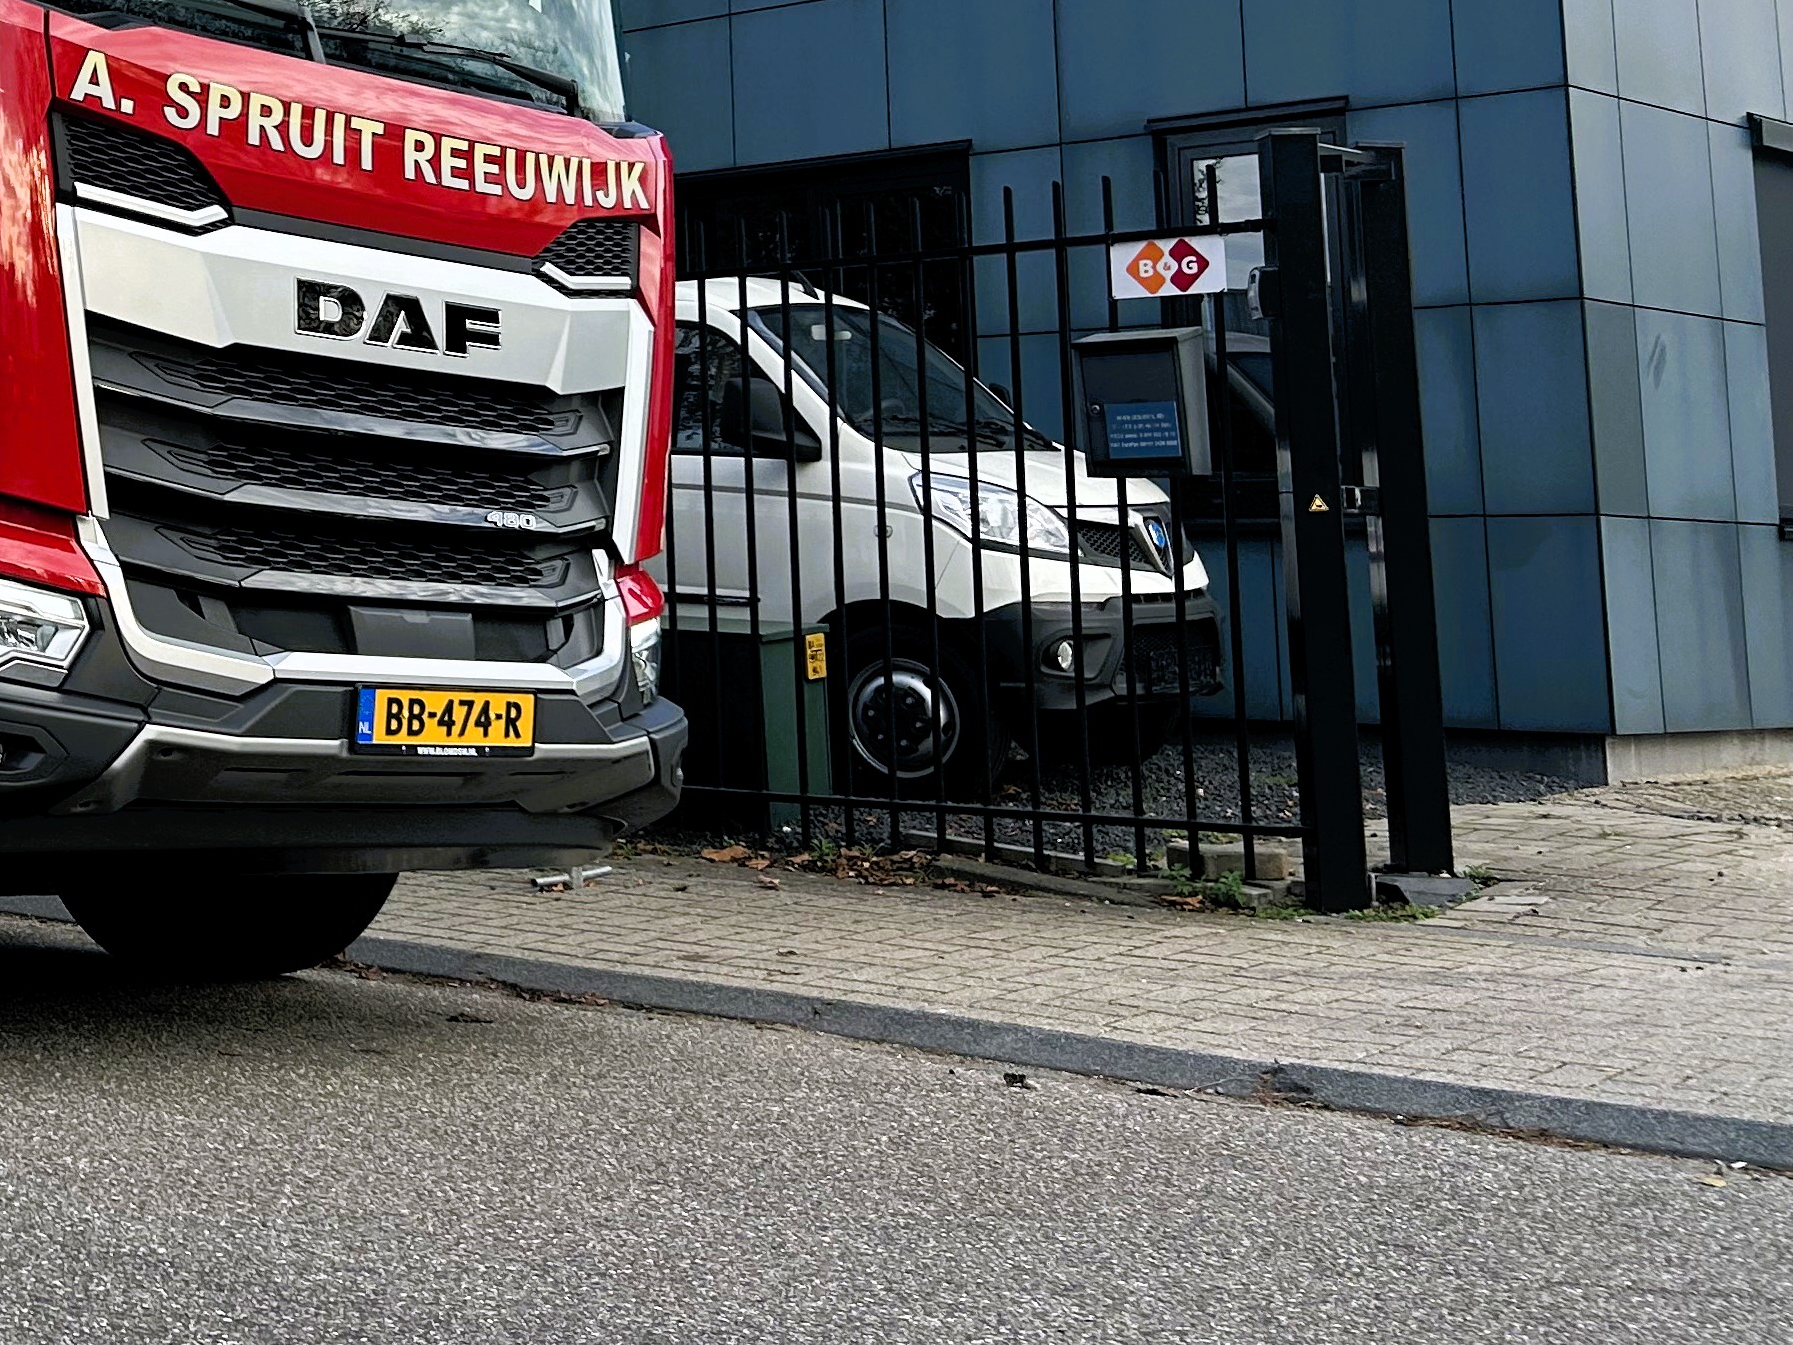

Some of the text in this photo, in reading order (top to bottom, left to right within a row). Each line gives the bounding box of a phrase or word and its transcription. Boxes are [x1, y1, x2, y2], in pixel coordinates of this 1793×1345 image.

[69, 49, 651, 210] A. SPRUIT REEUWIJK
[1138, 259, 1155, 278] B
[1181, 255, 1198, 275] G
[294, 276, 503, 359] DAF
[486, 510, 537, 530] 480
[358, 696, 523, 740] NL BB-474-R
